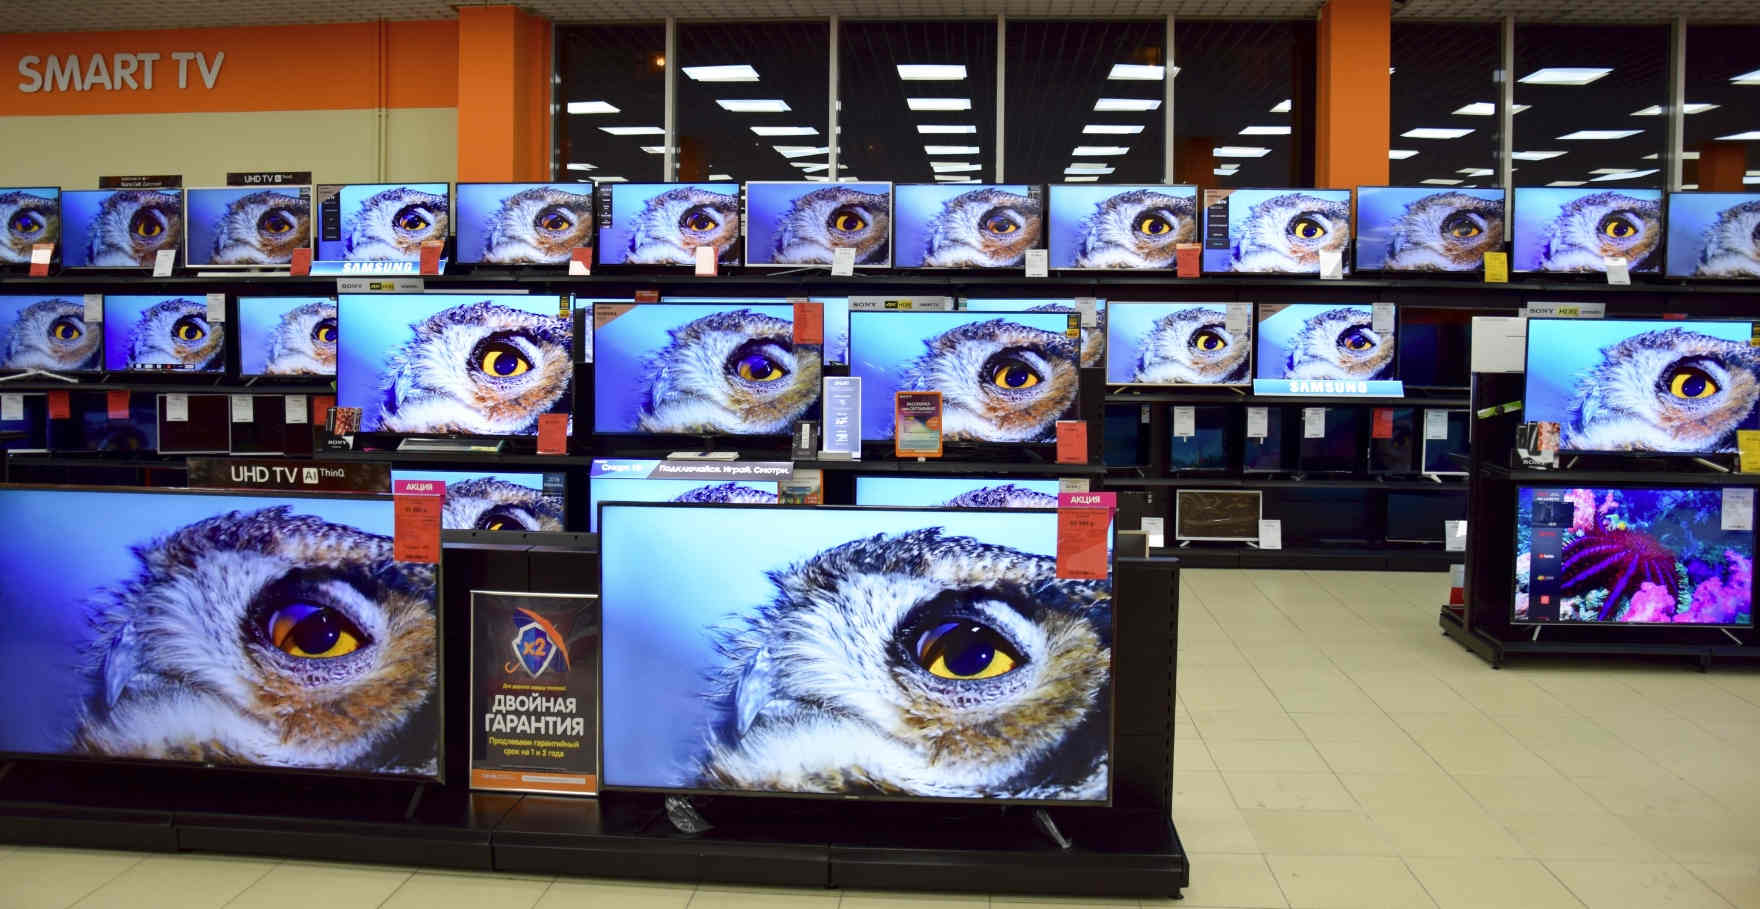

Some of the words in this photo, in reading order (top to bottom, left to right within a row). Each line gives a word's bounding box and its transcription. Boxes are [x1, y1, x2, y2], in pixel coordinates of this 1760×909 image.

[17, 51, 160, 93] SMART
[171, 51, 225, 90] TV
[244, 175, 261, 183] UHD
[262, 175, 274, 183] TV
[342, 262, 412, 273] SAMSUNG
[1289, 381, 1367, 393] SAMSUNG
[231, 465, 268, 483] UHD
[272, 466, 298, 483] TV
[319, 468, 345, 479] ThinQ
[406, 483, 433, 492] АКЦИЯ
[1070, 495, 1101, 504] АКЦИЯ
[492, 693, 577, 714] ДВОЙНАЯ
[484, 713, 585, 736] ГАРАНТИЯ
[534, 739, 580, 749] гарантийный
[503, 748, 520, 757] срок
